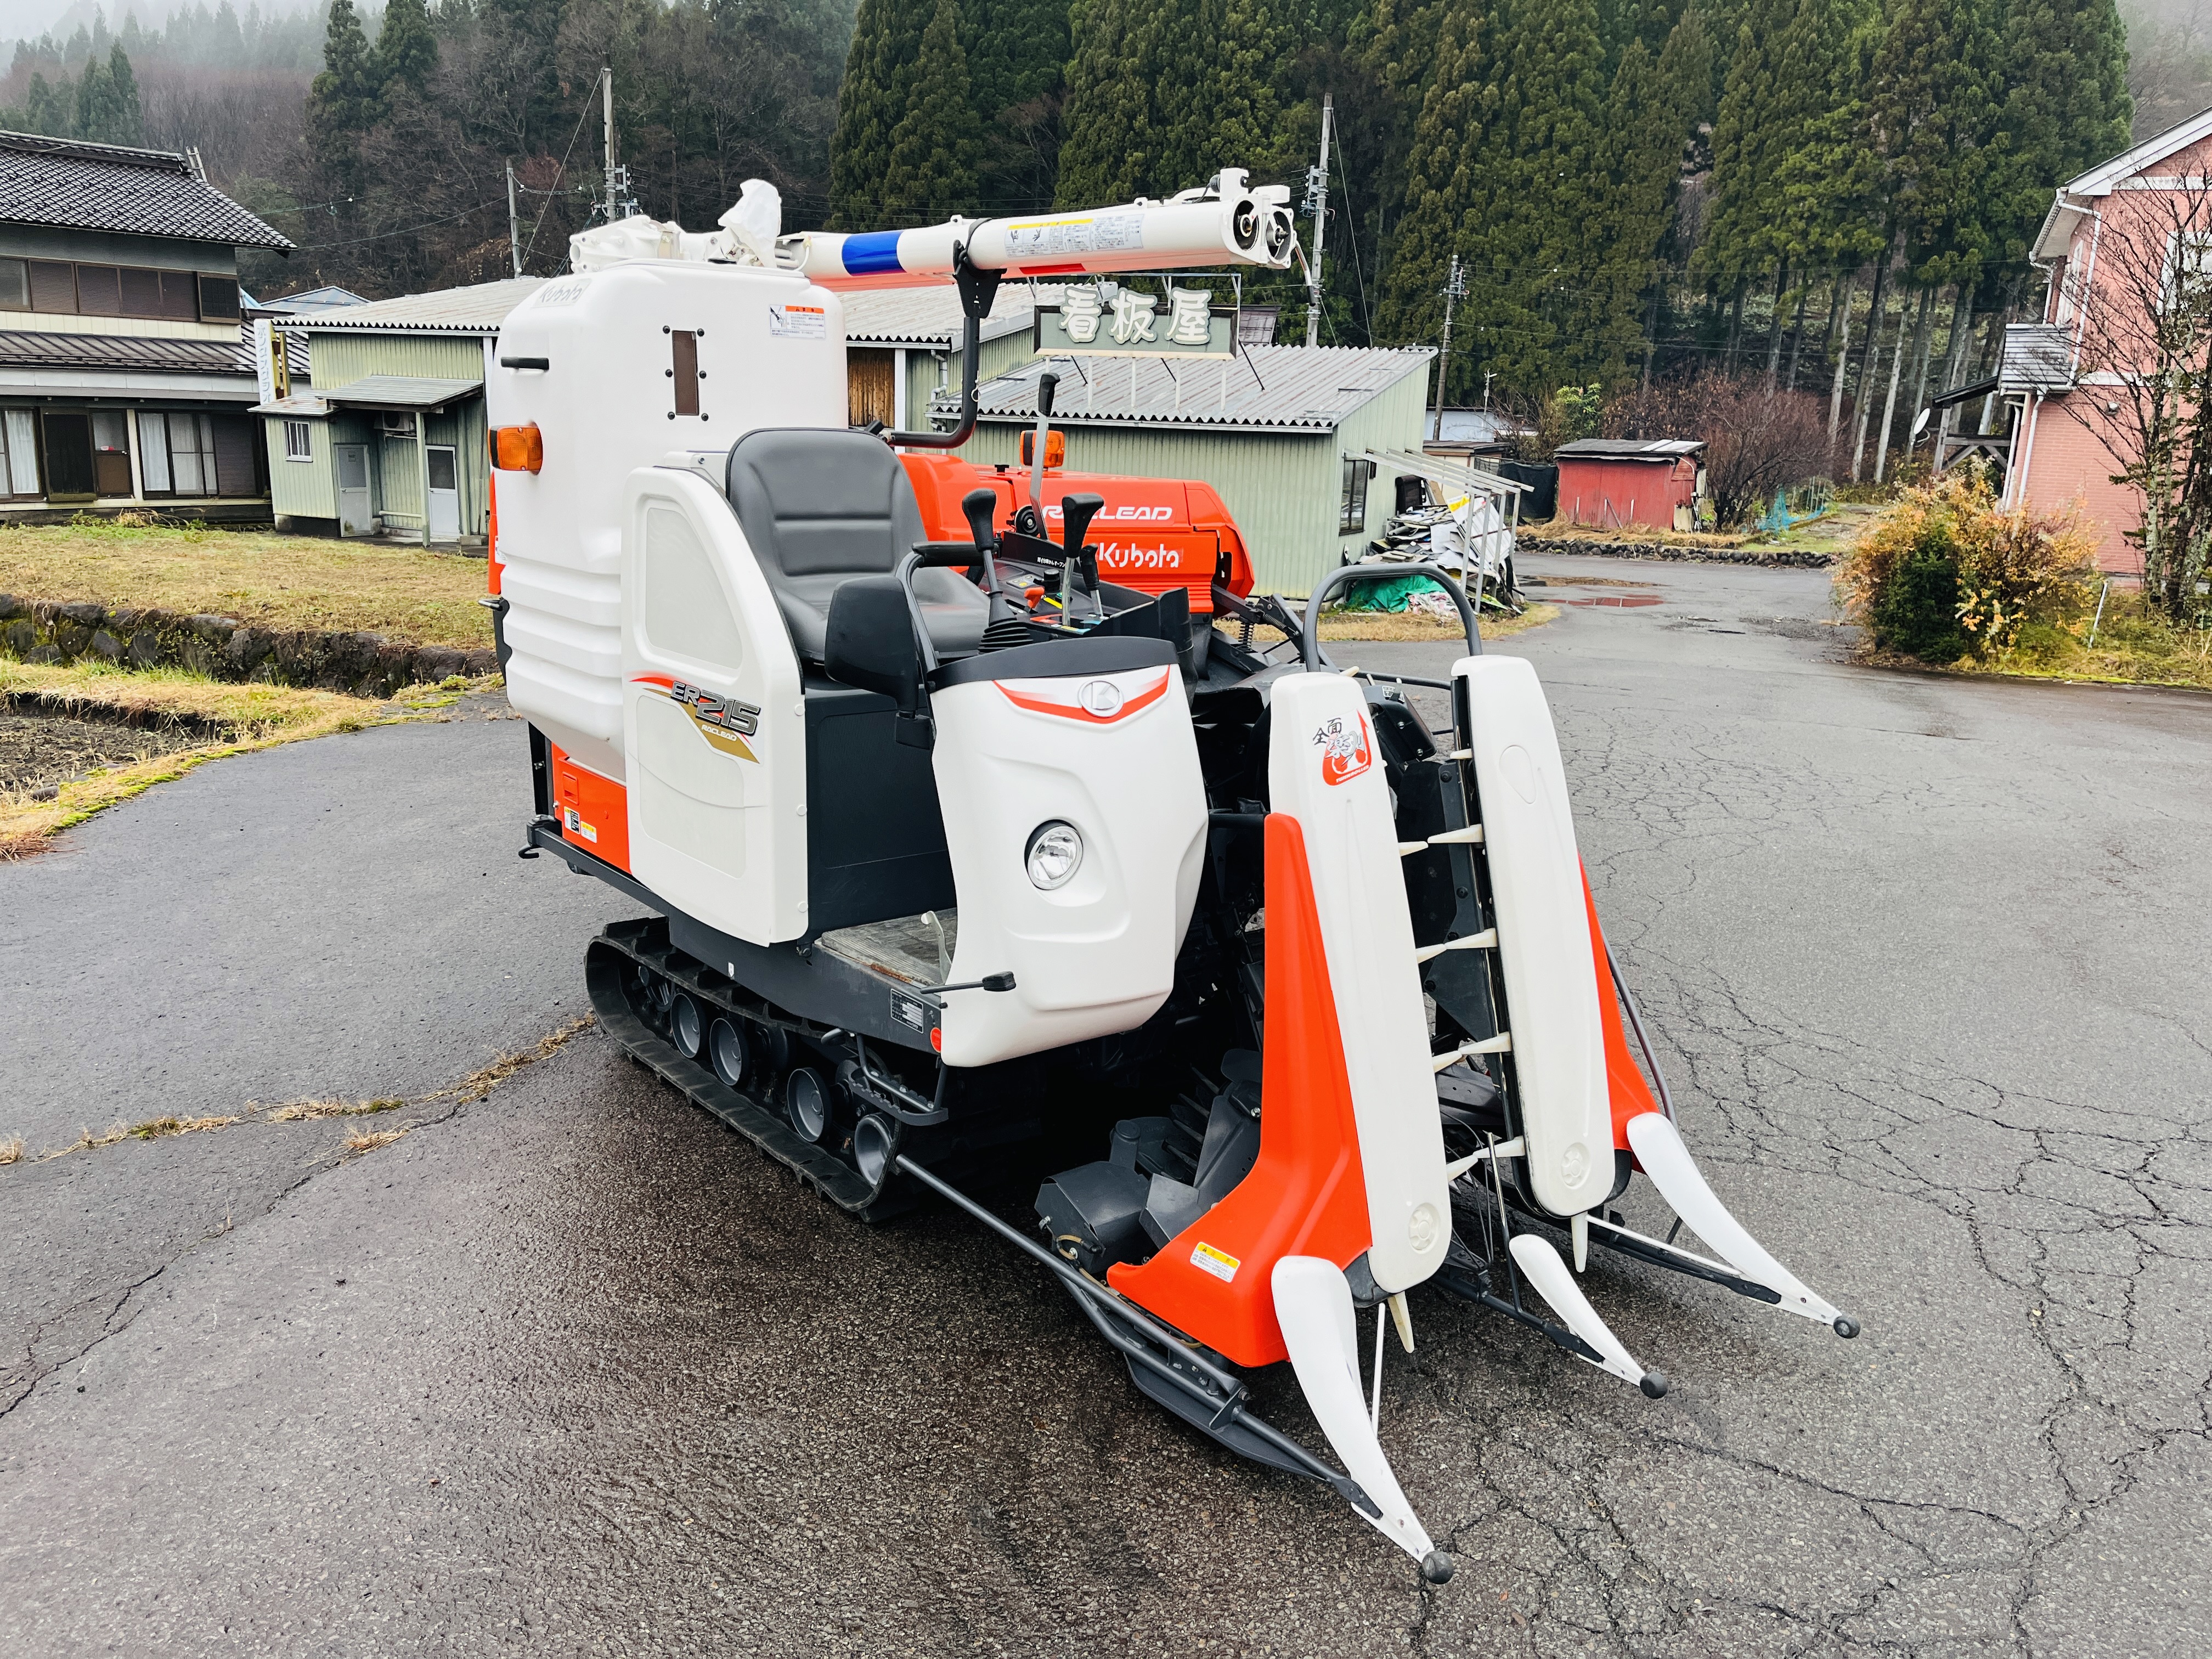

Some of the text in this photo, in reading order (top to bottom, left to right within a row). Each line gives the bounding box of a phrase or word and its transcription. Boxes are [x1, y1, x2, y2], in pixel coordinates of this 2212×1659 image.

[539, 284, 583, 303] Kubota
[1059, 287, 1210, 343] 看板屋
[1042, 505, 1173, 521] RLEAD
[1098, 542, 1180, 568] Kubota
[670, 680, 761, 737] ER215
[701, 724, 737, 742] RACLEAD
